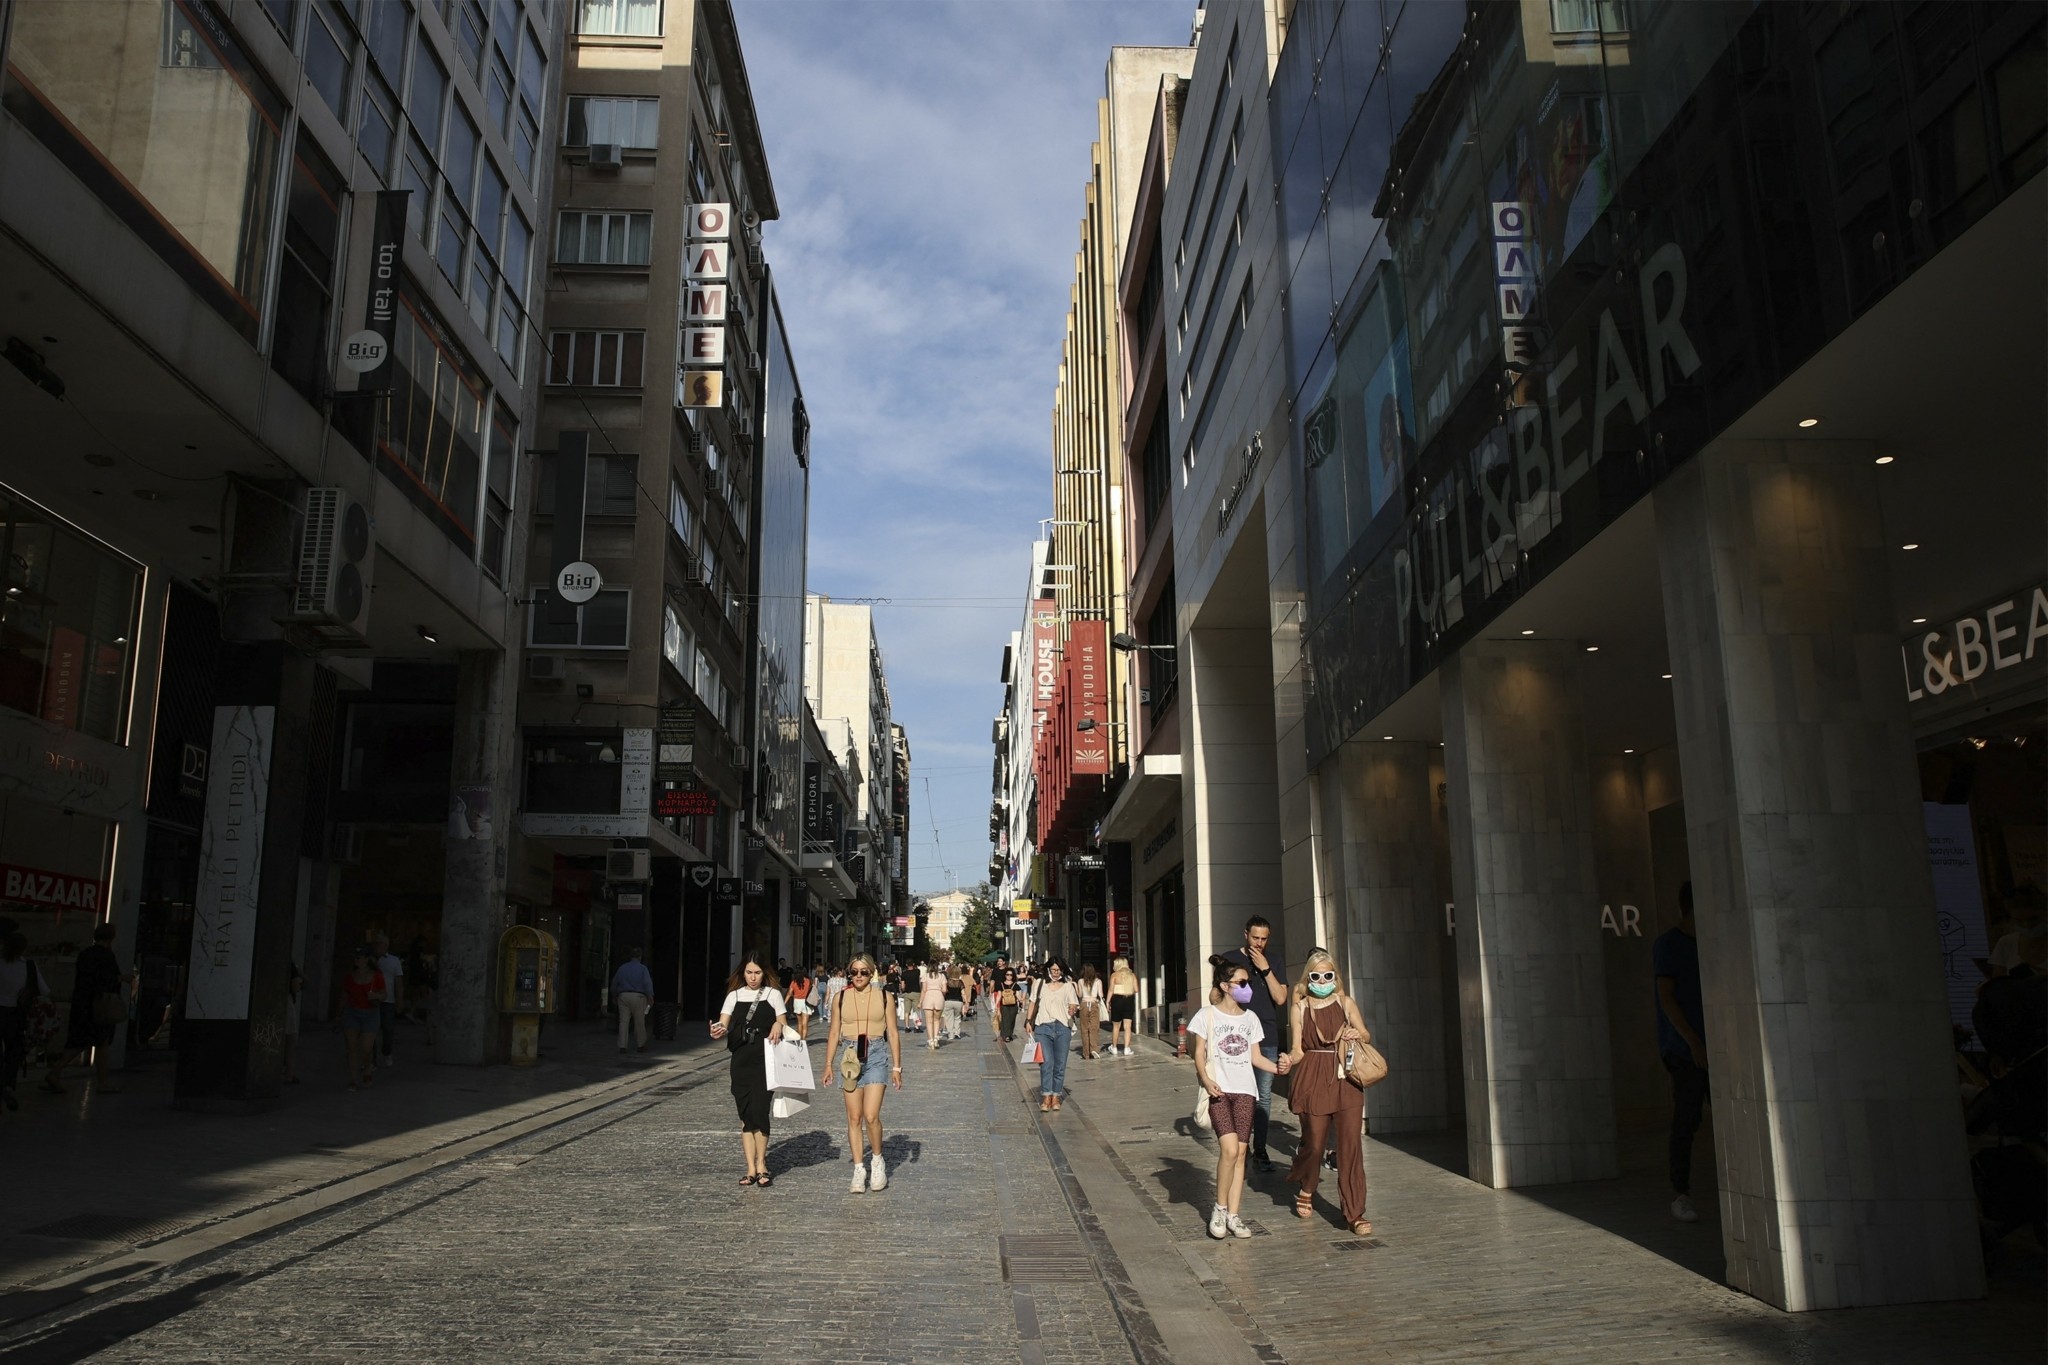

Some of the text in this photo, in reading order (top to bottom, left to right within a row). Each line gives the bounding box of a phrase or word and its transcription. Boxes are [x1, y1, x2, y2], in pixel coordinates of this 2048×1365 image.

[373, 242, 397, 321] too tall
[348, 342, 380, 358] Big
[1394, 242, 1702, 648] PULL&BEAR
[564, 574, 593, 589] Big
[1038, 638, 1054, 700] HOUSE
[1082, 645, 1095, 744] FUKYBUDDHA
[658, 799, 708, 807] ΚΟΡΝΑΡΟΥ
[667, 791, 707, 799] ΕΙΣΟΔΟΣ
[808, 775, 817, 827] SEPHORA
[746, 836, 764, 848] Ths
[215, 753, 250, 968] FRATELLI PETRIDI
[5, 869, 97, 909] BAZAAR
[745, 880, 763, 891] Ths
[792, 914, 806, 923] Ths
